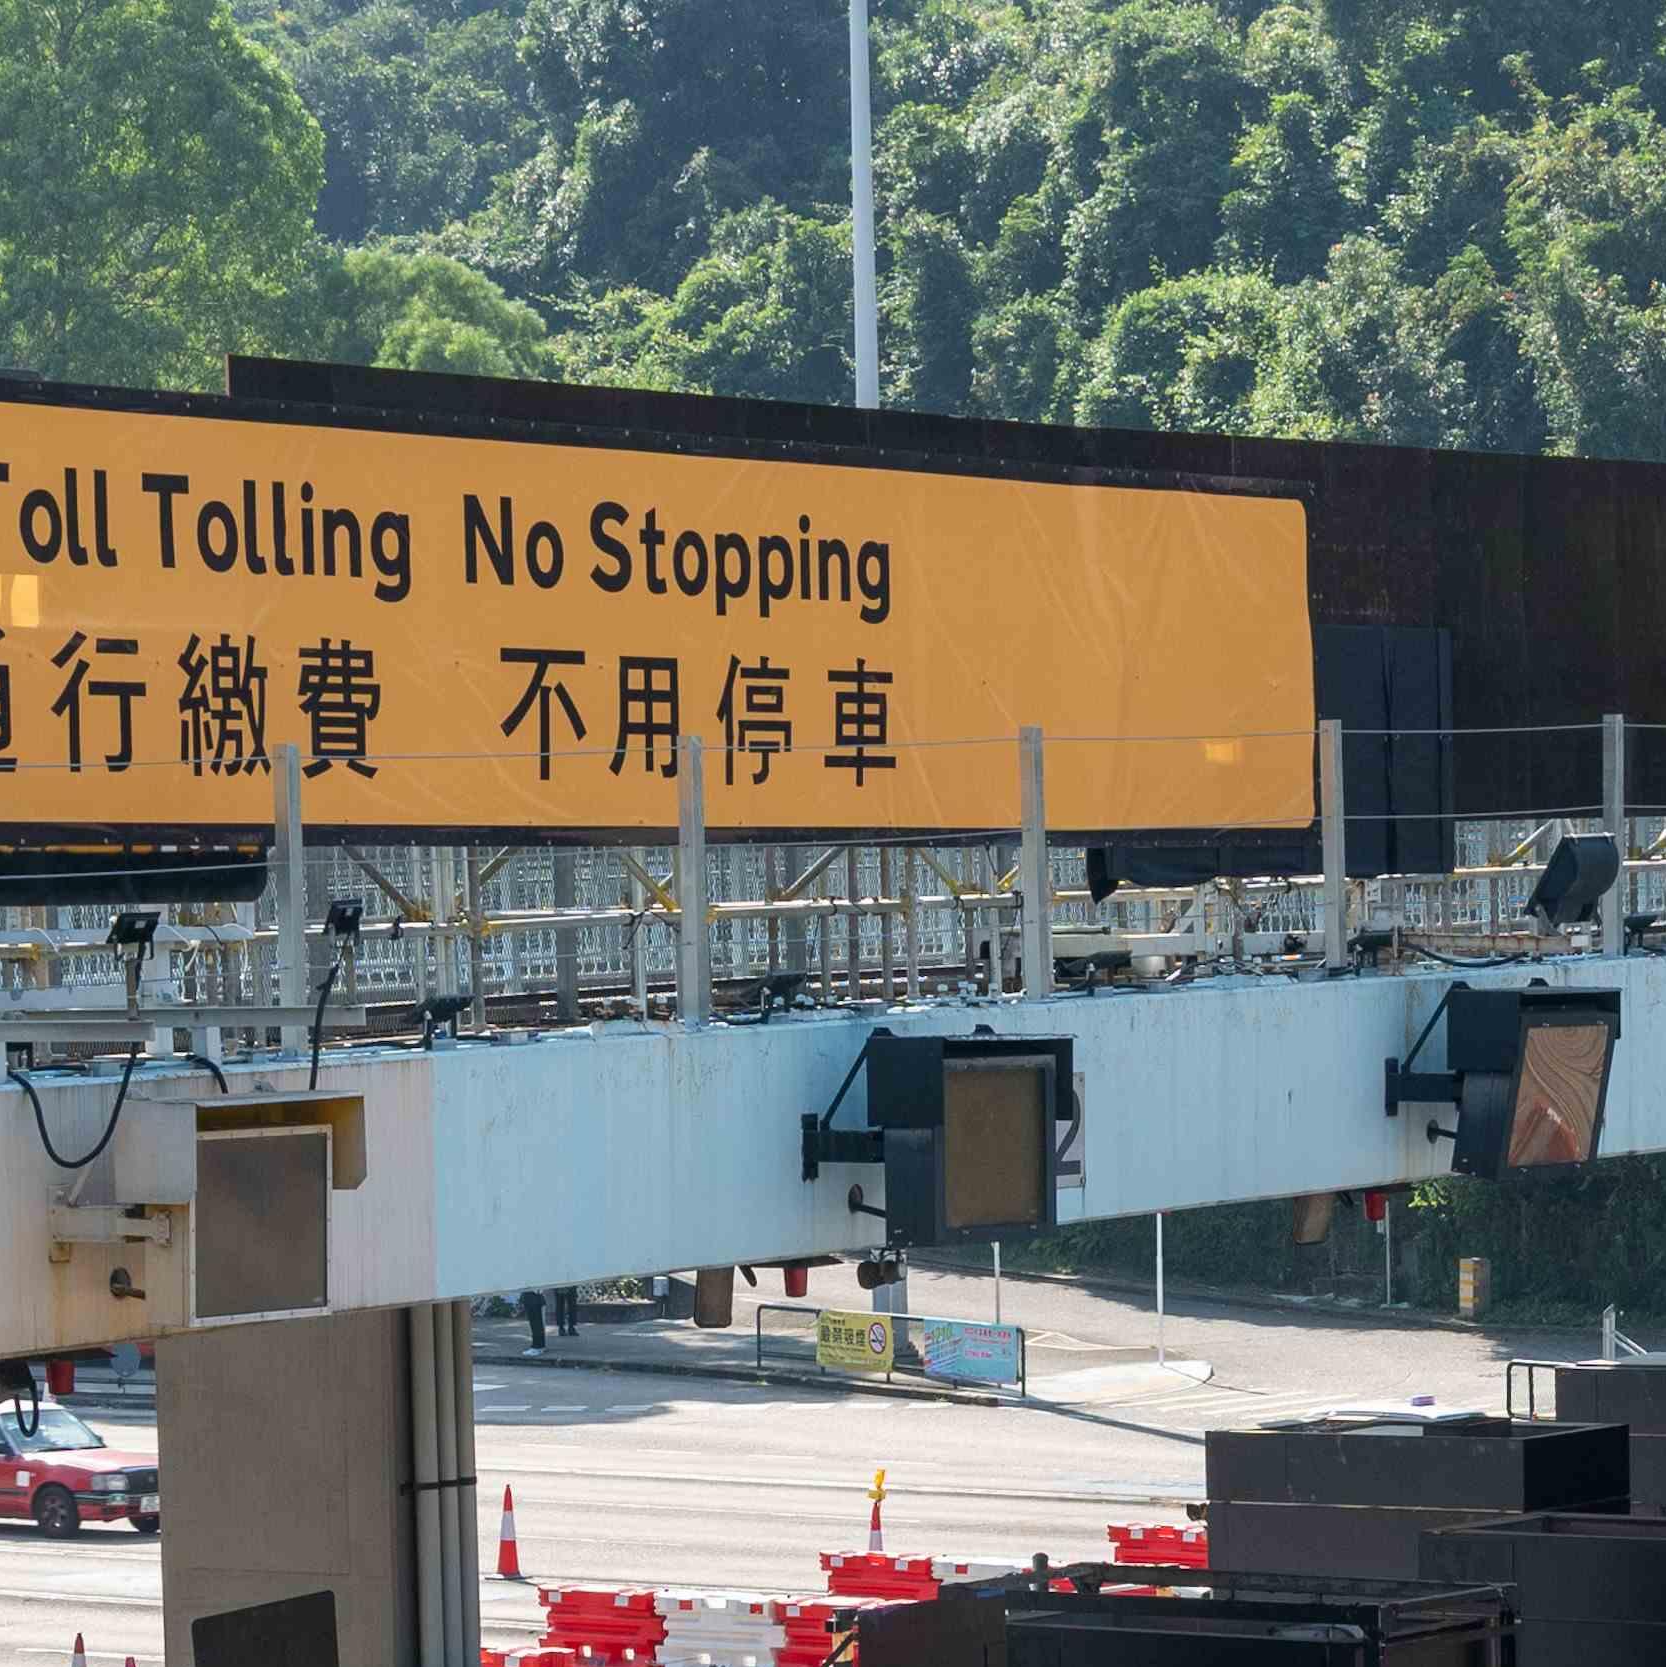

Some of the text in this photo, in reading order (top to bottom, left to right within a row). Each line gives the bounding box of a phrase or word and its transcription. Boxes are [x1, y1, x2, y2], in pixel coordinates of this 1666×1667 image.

[143, 473, 411, 604] Tolling
[465, 494, 564, 591] No
[591, 501, 891, 624] Stopping
[500, 646, 896, 788] 不用停車
